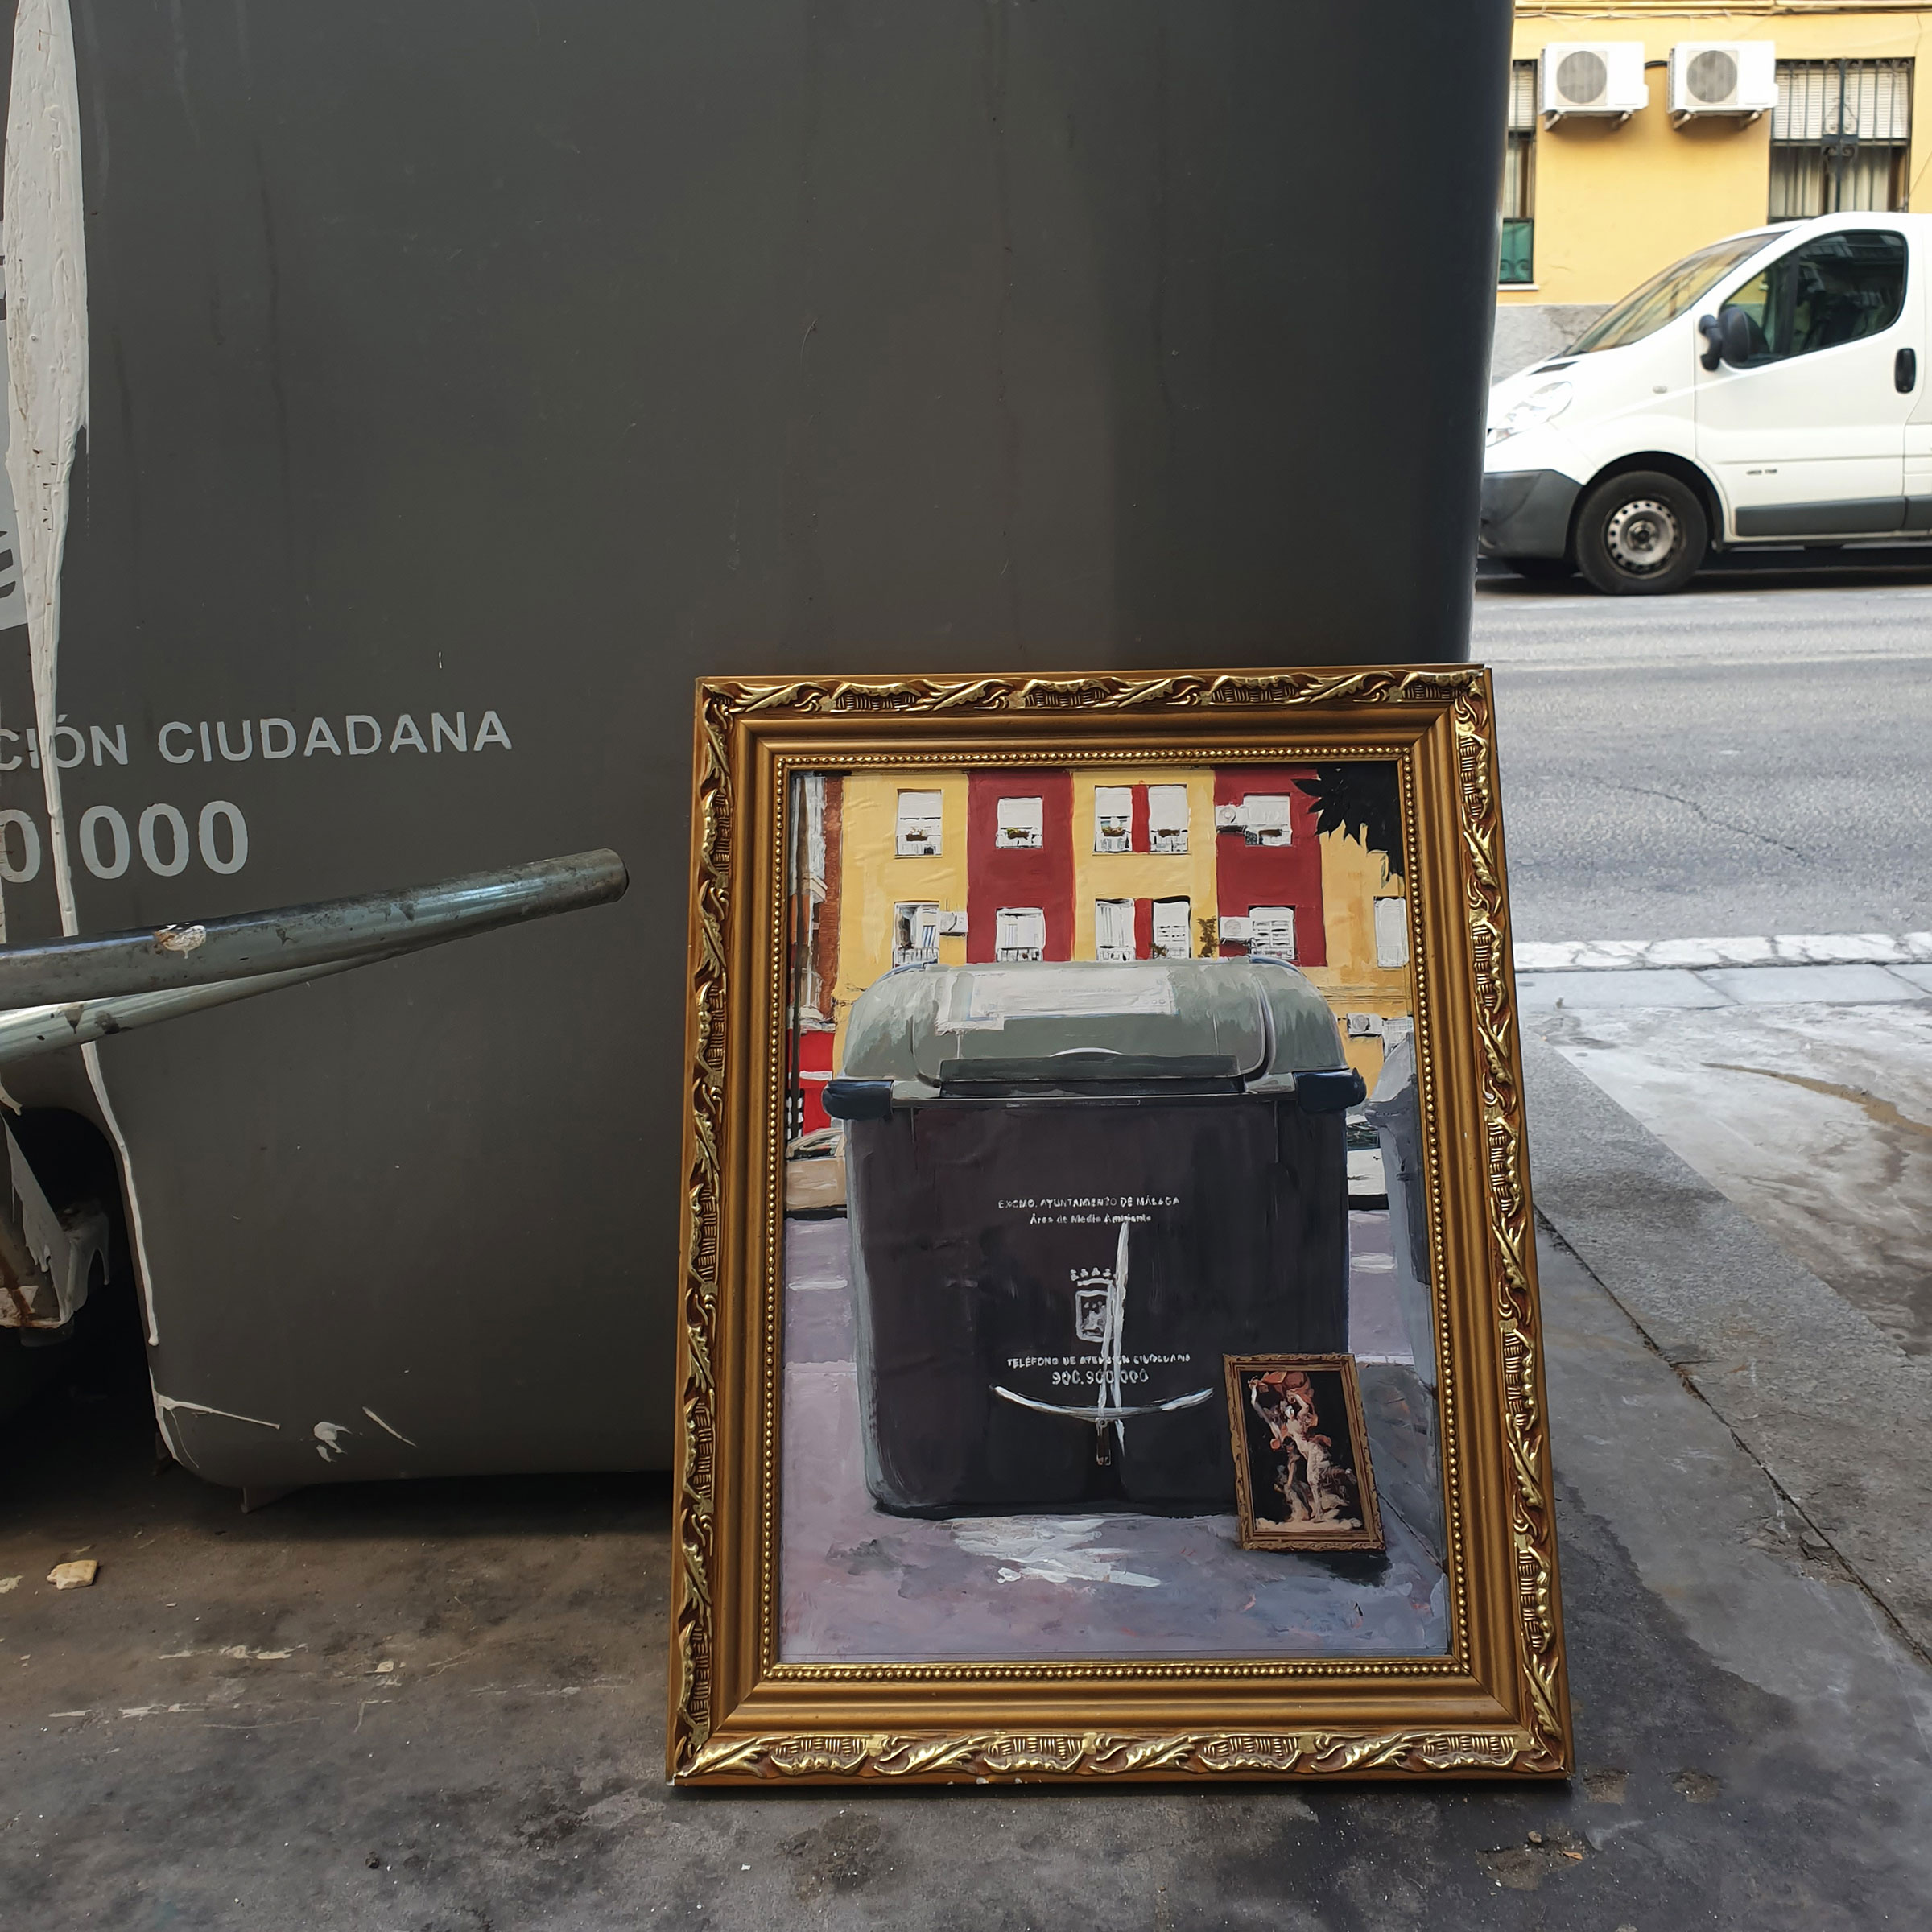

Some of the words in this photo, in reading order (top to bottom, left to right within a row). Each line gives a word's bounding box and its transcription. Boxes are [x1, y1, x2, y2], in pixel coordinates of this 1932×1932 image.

[0, 714, 129, 771] CIÓN
[158, 710, 512, 764] CIUDADANA
[1040, 1196, 1117, 1208] AYUNTAMIENTO
[1120, 1196, 1133, 1208] DE
[1056, 1214, 1068, 1224] de
[1071, 1214, 1102, 1224] Medio
[1006, 1356, 1059, 1369] TELÉFONO
[1062, 1356, 1076, 1366] DE
[1080, 1354, 1130, 1365] ATENN
